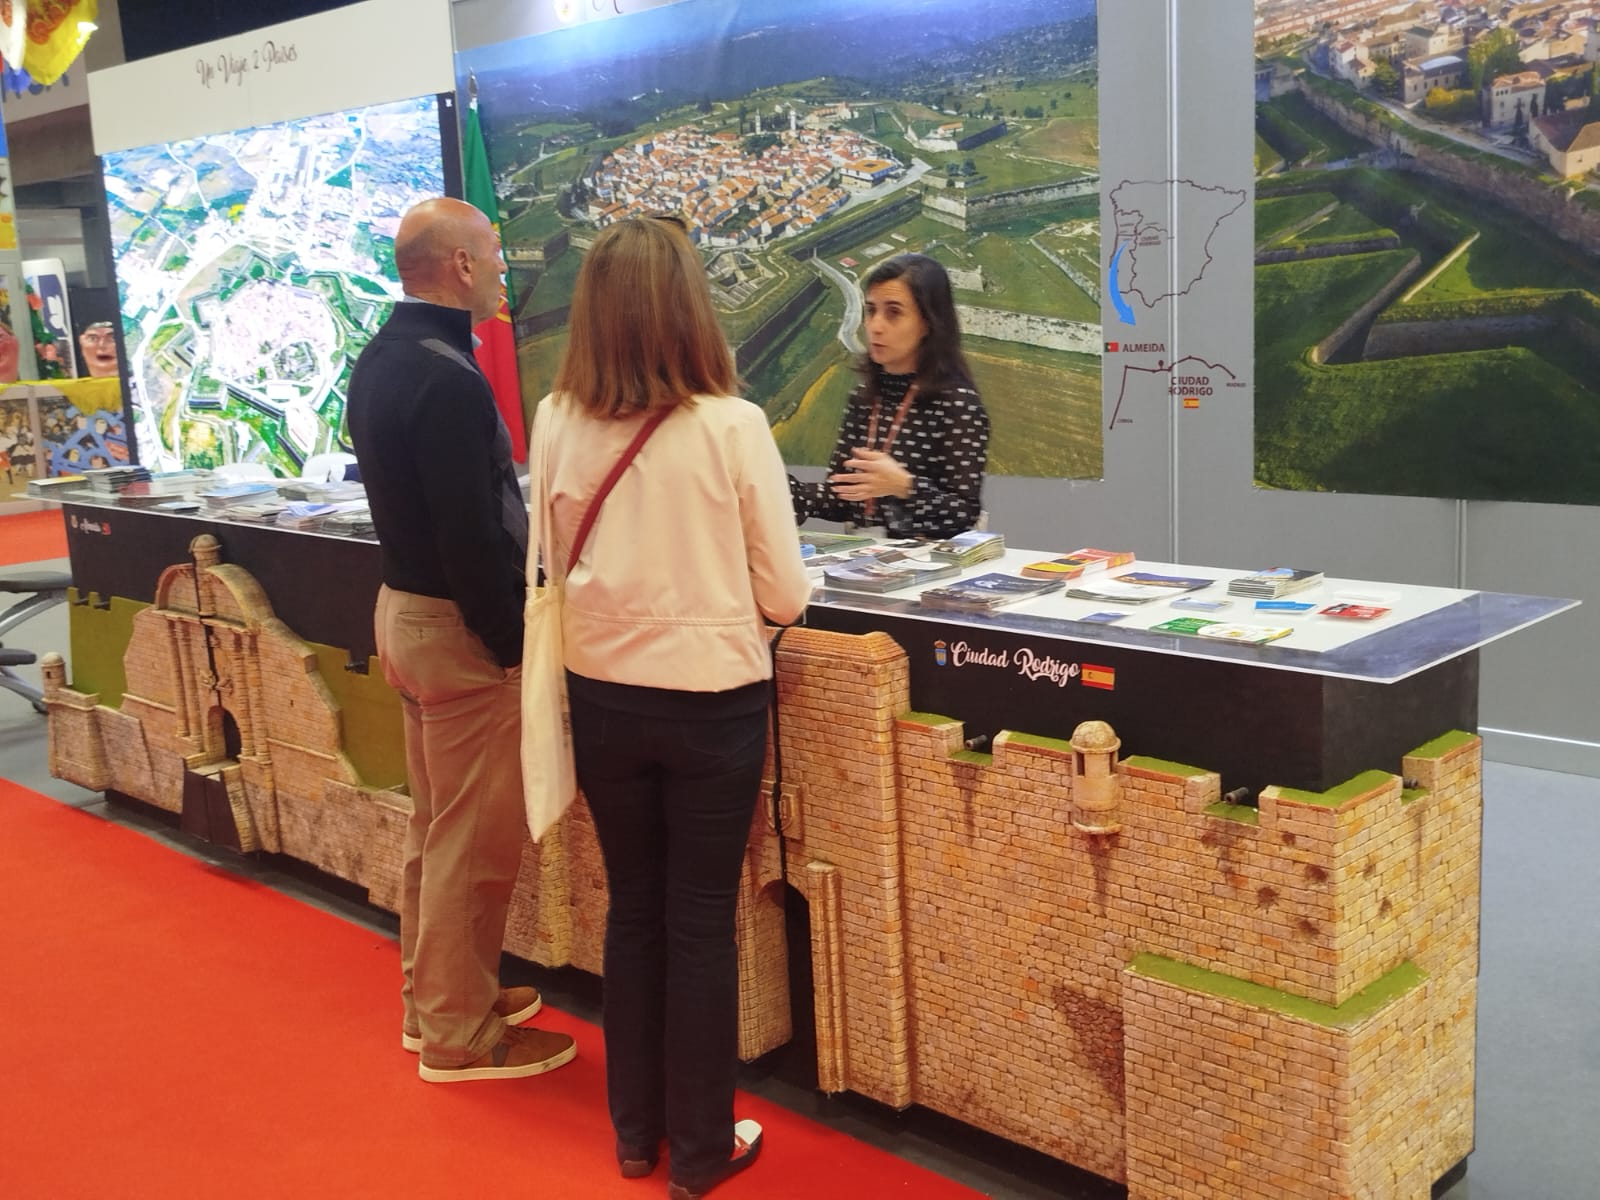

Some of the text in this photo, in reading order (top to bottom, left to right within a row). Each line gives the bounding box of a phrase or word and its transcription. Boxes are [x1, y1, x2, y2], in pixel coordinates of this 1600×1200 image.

[1122, 343, 1166, 353] ALMEIDA
[1170, 376, 1210, 386] CIUDAD
[951, 641, 1080, 688] Ciudad Rodrigo
